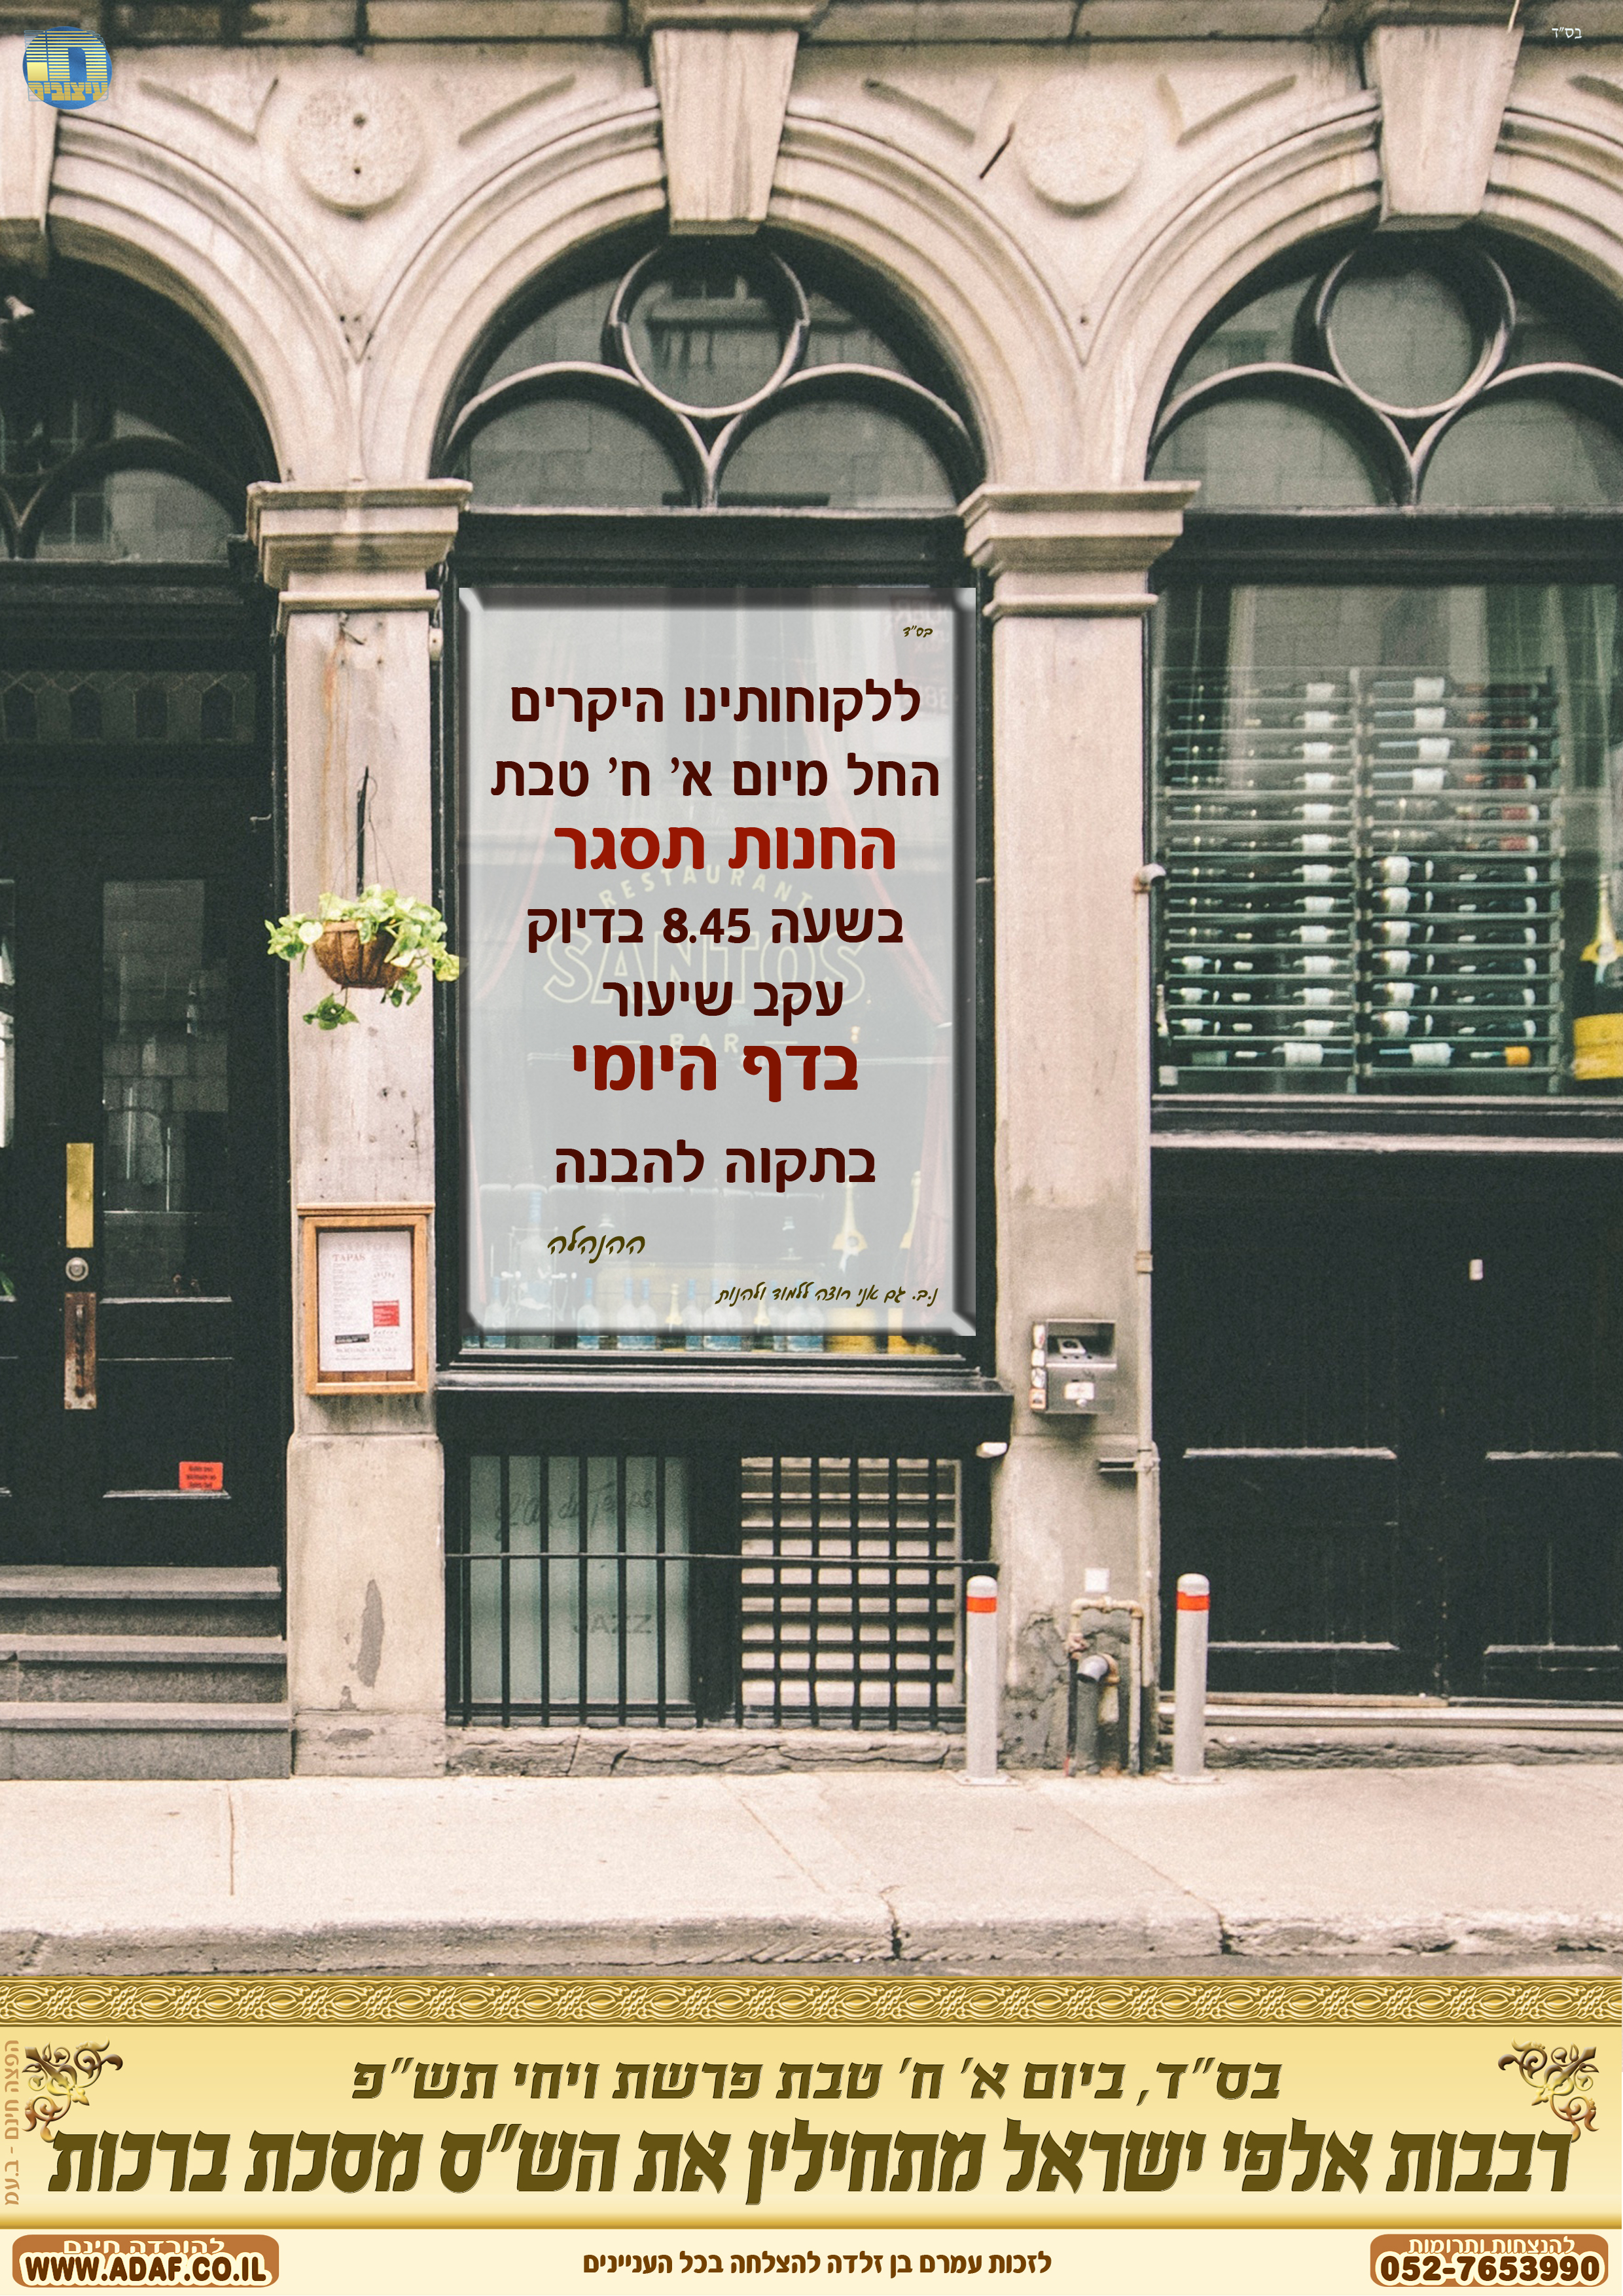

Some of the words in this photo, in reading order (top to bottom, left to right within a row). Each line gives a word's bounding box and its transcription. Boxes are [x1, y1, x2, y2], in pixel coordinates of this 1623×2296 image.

[598, 864, 813, 912] RESTAURANT
[543, 929, 866, 1005] SANTOS
[669, 1033, 740, 1053] BAR
